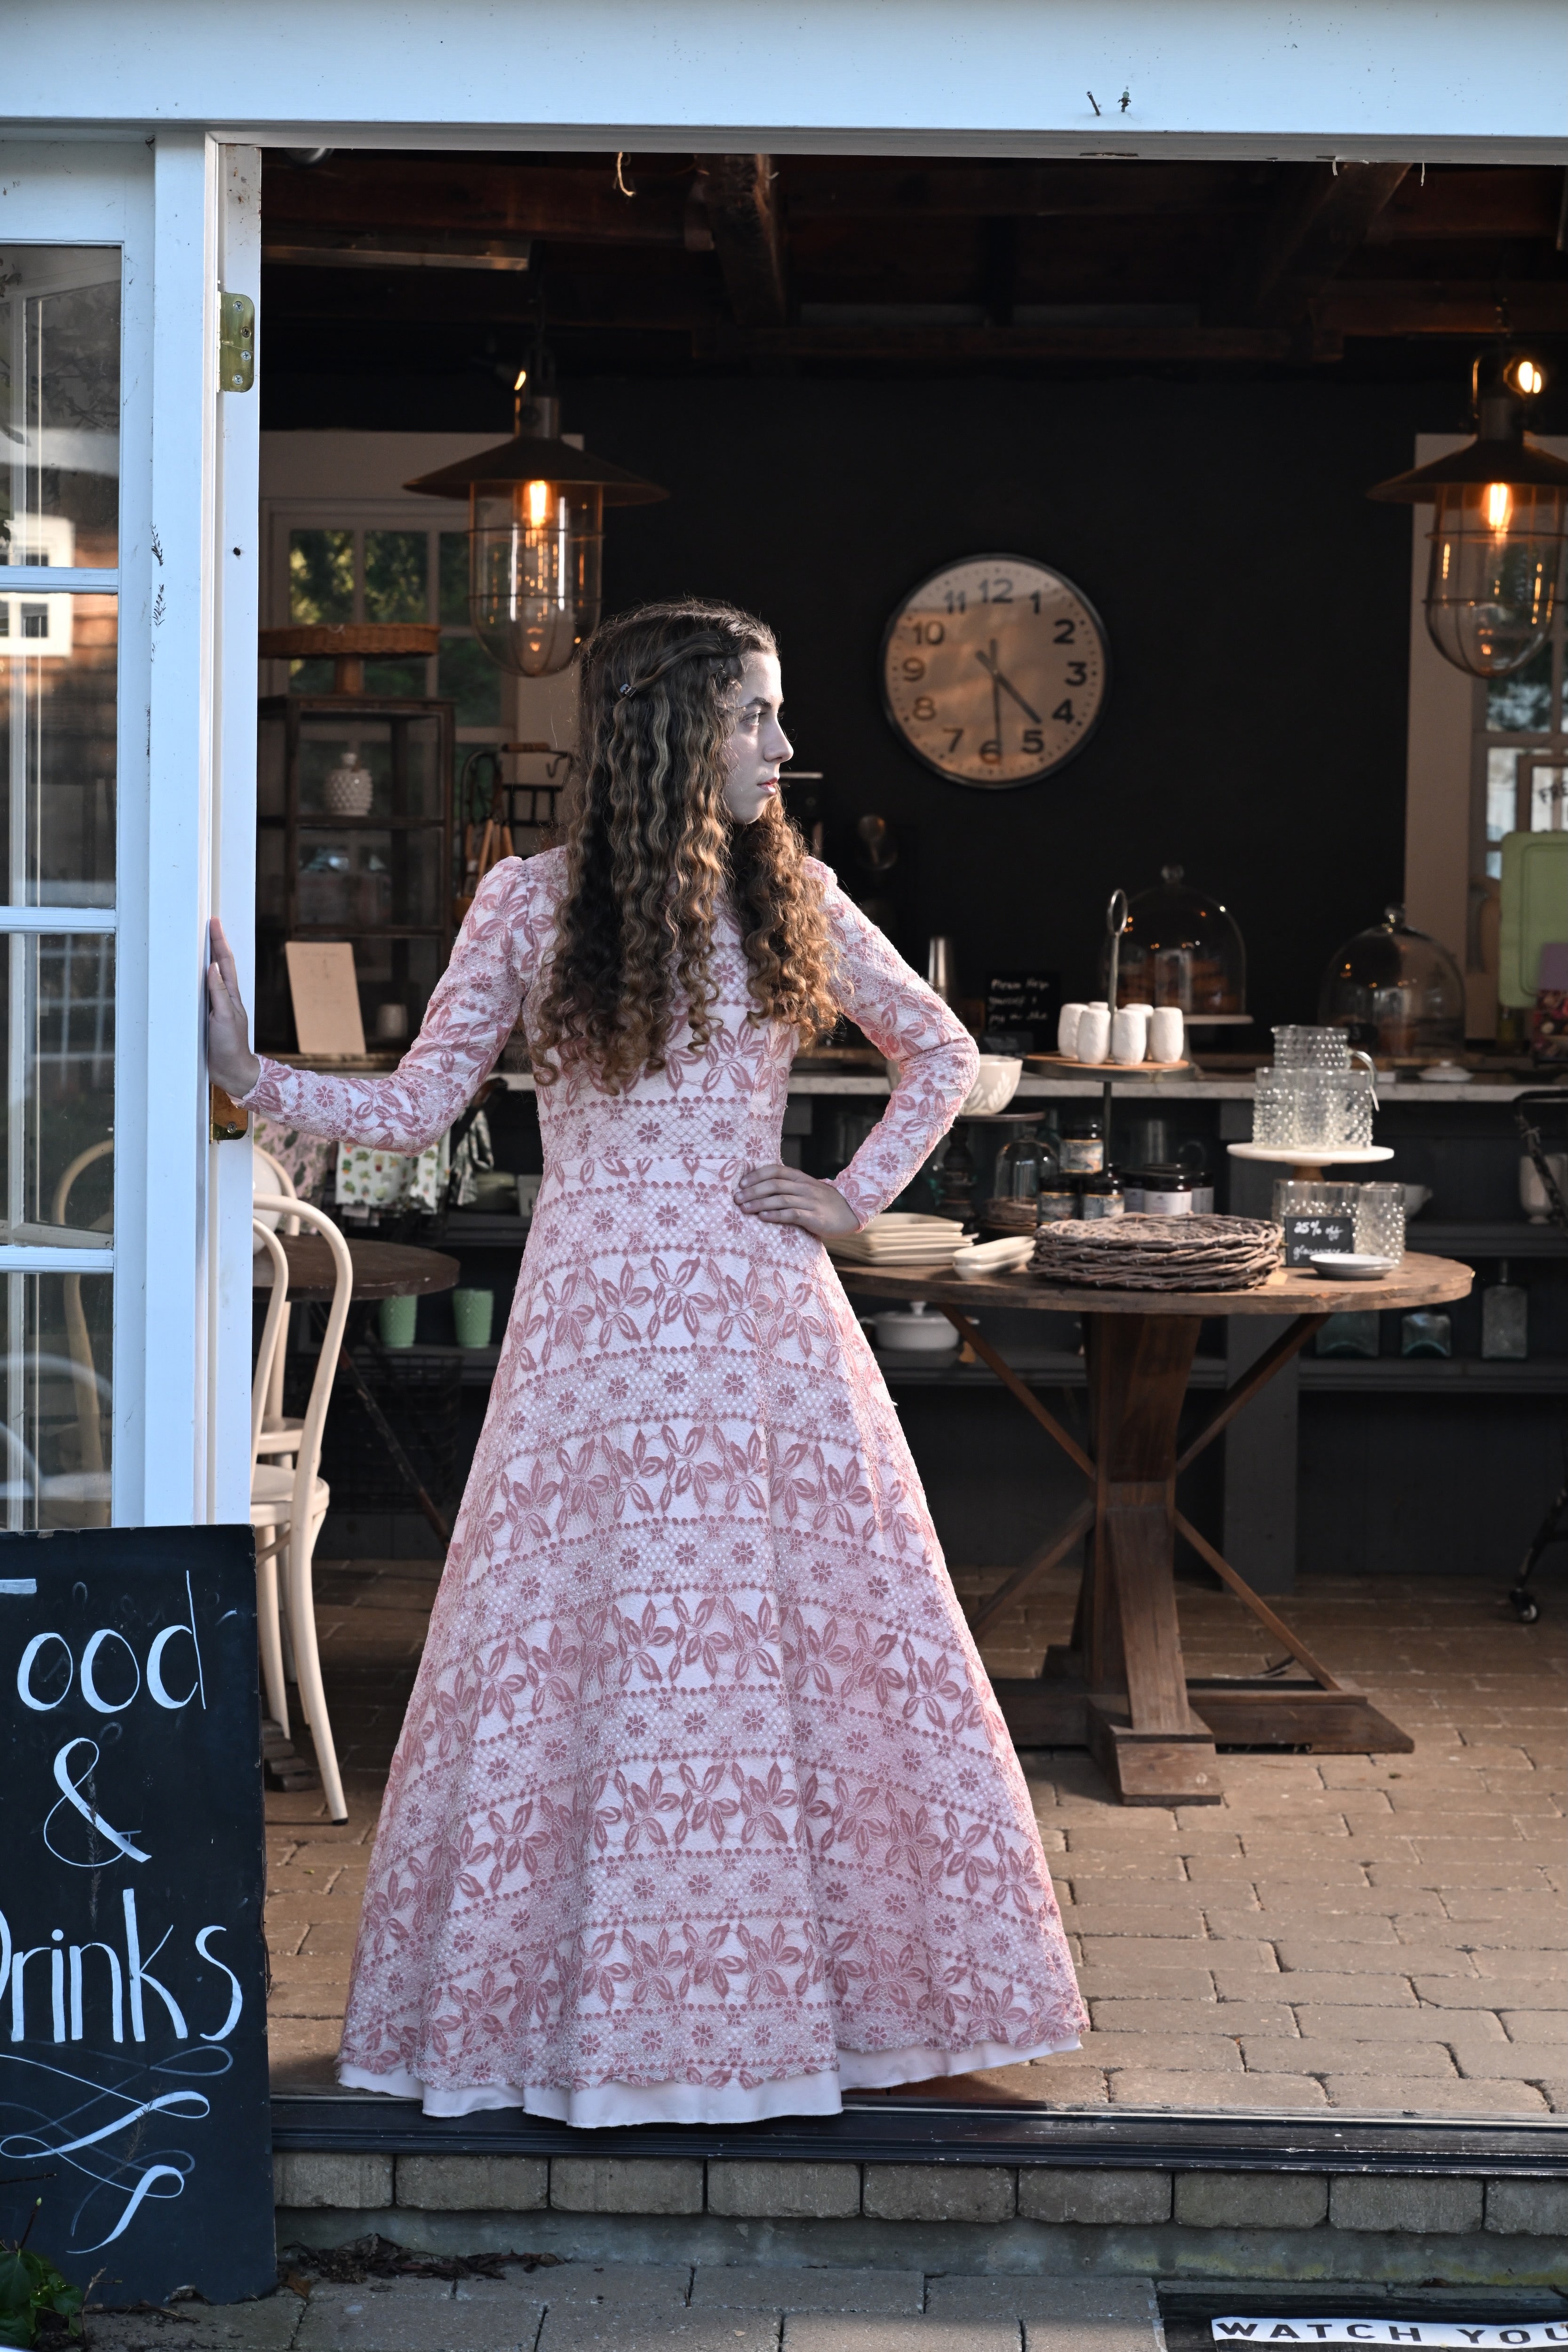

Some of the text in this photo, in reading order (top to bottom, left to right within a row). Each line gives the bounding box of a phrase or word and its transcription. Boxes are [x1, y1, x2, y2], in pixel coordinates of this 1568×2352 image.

[945, 590, 966, 613] 11
[979, 578, 1013, 604] 12
[1030, 590, 1040, 614] 1
[912, 620, 945, 645] 10
[1053, 619, 1075, 644] 2
[902, 657, 925, 682] 9
[1065, 661, 1087, 686] 3
[913, 696, 936, 721] 8
[1051, 699, 1074, 723] 4
[943, 728, 964, 752] 7
[979, 740, 1001, 764] 6
[1021, 731, 1044, 754] 5
[1294, 1220, 1344, 1241] 25% off
[0, 1570, 206, 1713] ood
[44, 1738, 152, 1867] &
[0, 1888, 243, 2043] rinks
[1216, 2322, 1568, 2344] WATCH YOU
